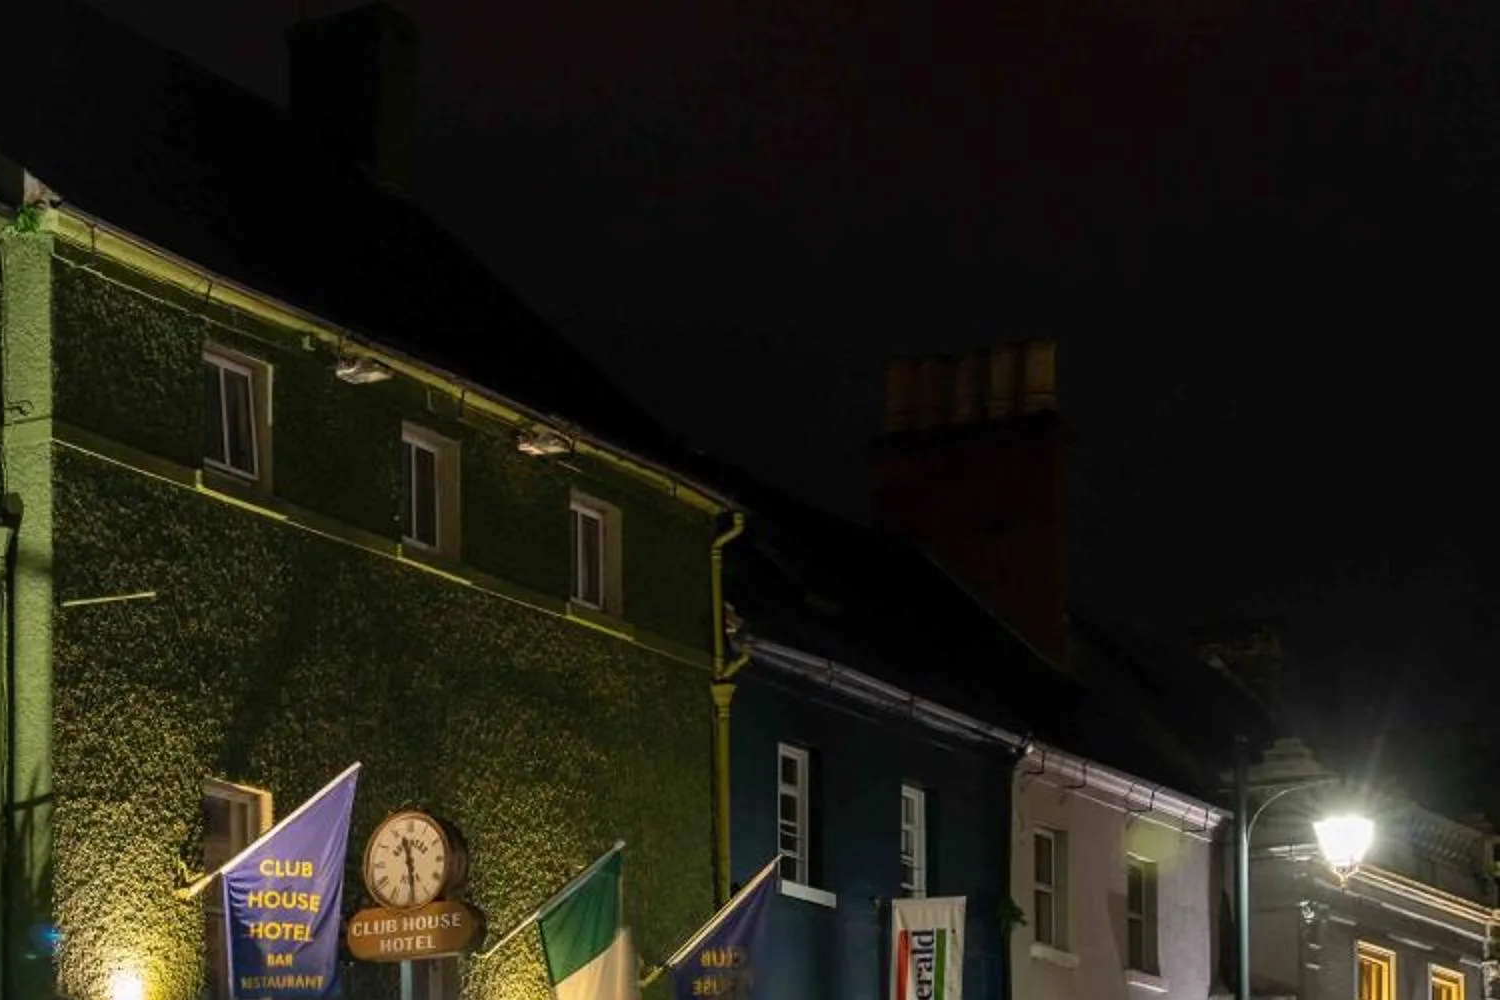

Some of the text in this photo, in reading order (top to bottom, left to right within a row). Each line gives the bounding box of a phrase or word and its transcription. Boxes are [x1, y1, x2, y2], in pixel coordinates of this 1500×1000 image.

[259, 858, 313, 878] CLUB
[247, 890, 321, 913] HOUSE
[248, 921, 314, 942] HOTEL
[352, 912, 463, 937] CLUB HOUSE
[380, 935, 437, 953] HOTEL
[267, 953, 294, 967] BAR
